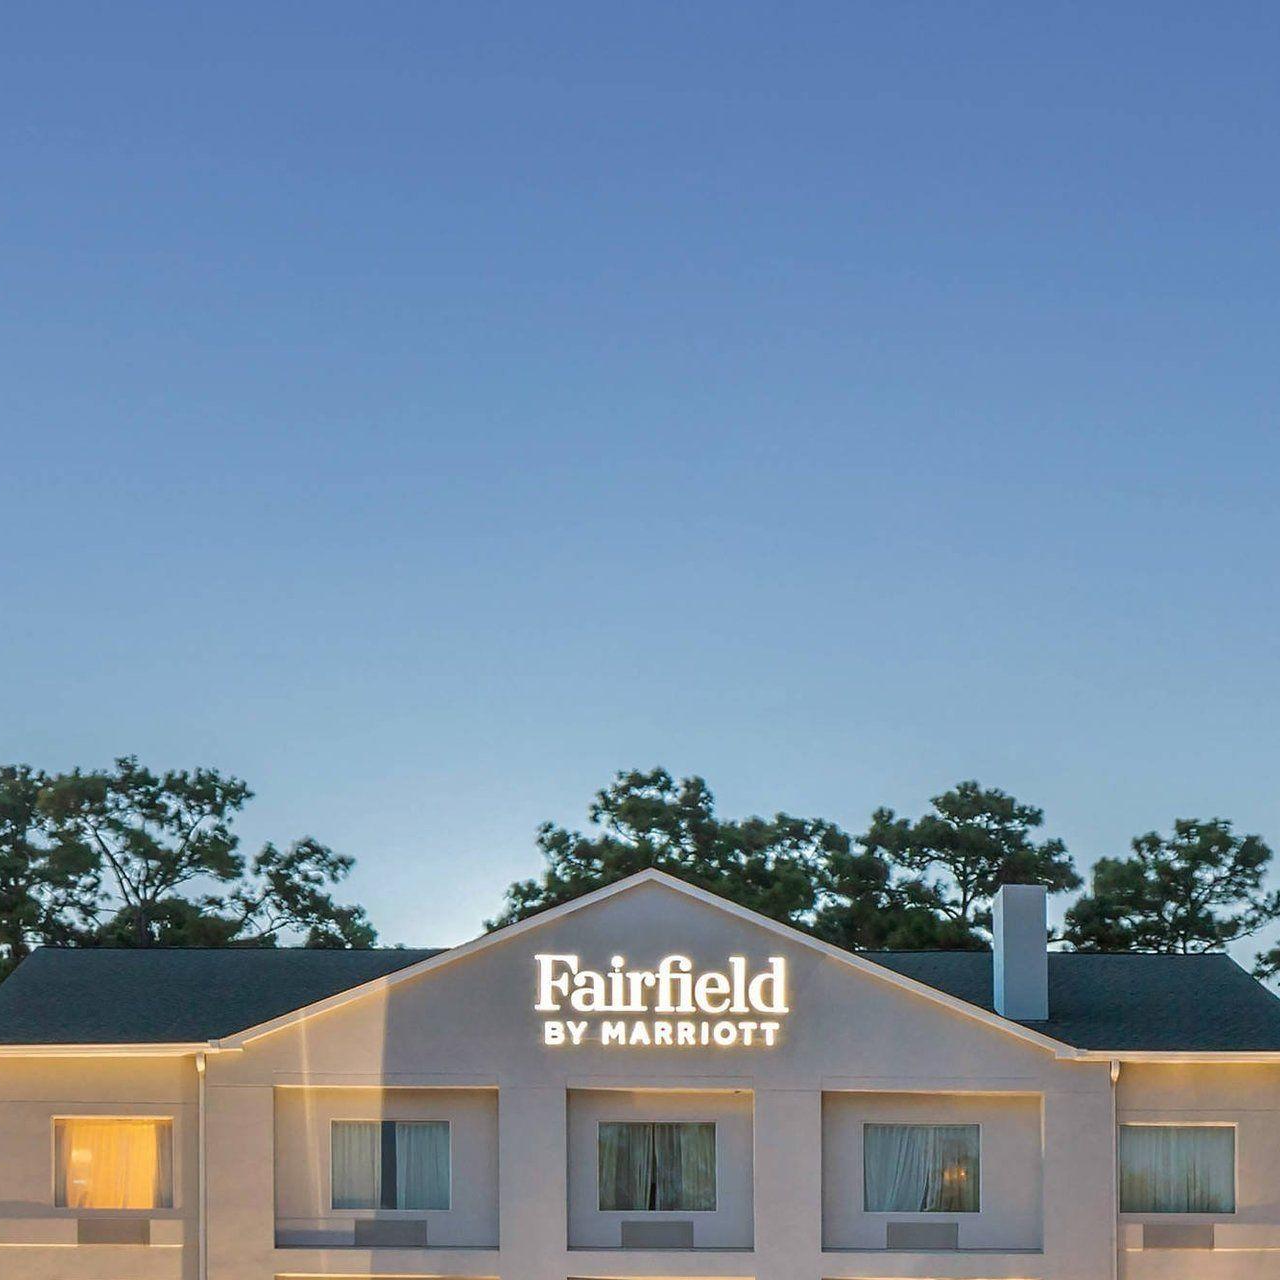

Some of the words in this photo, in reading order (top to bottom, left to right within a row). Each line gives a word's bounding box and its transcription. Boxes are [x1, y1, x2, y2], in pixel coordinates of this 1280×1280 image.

[534, 953, 789, 1014] Fairfield
[544, 1020, 588, 1045] BY
[601, 1020, 780, 1046] MARRIOTT
